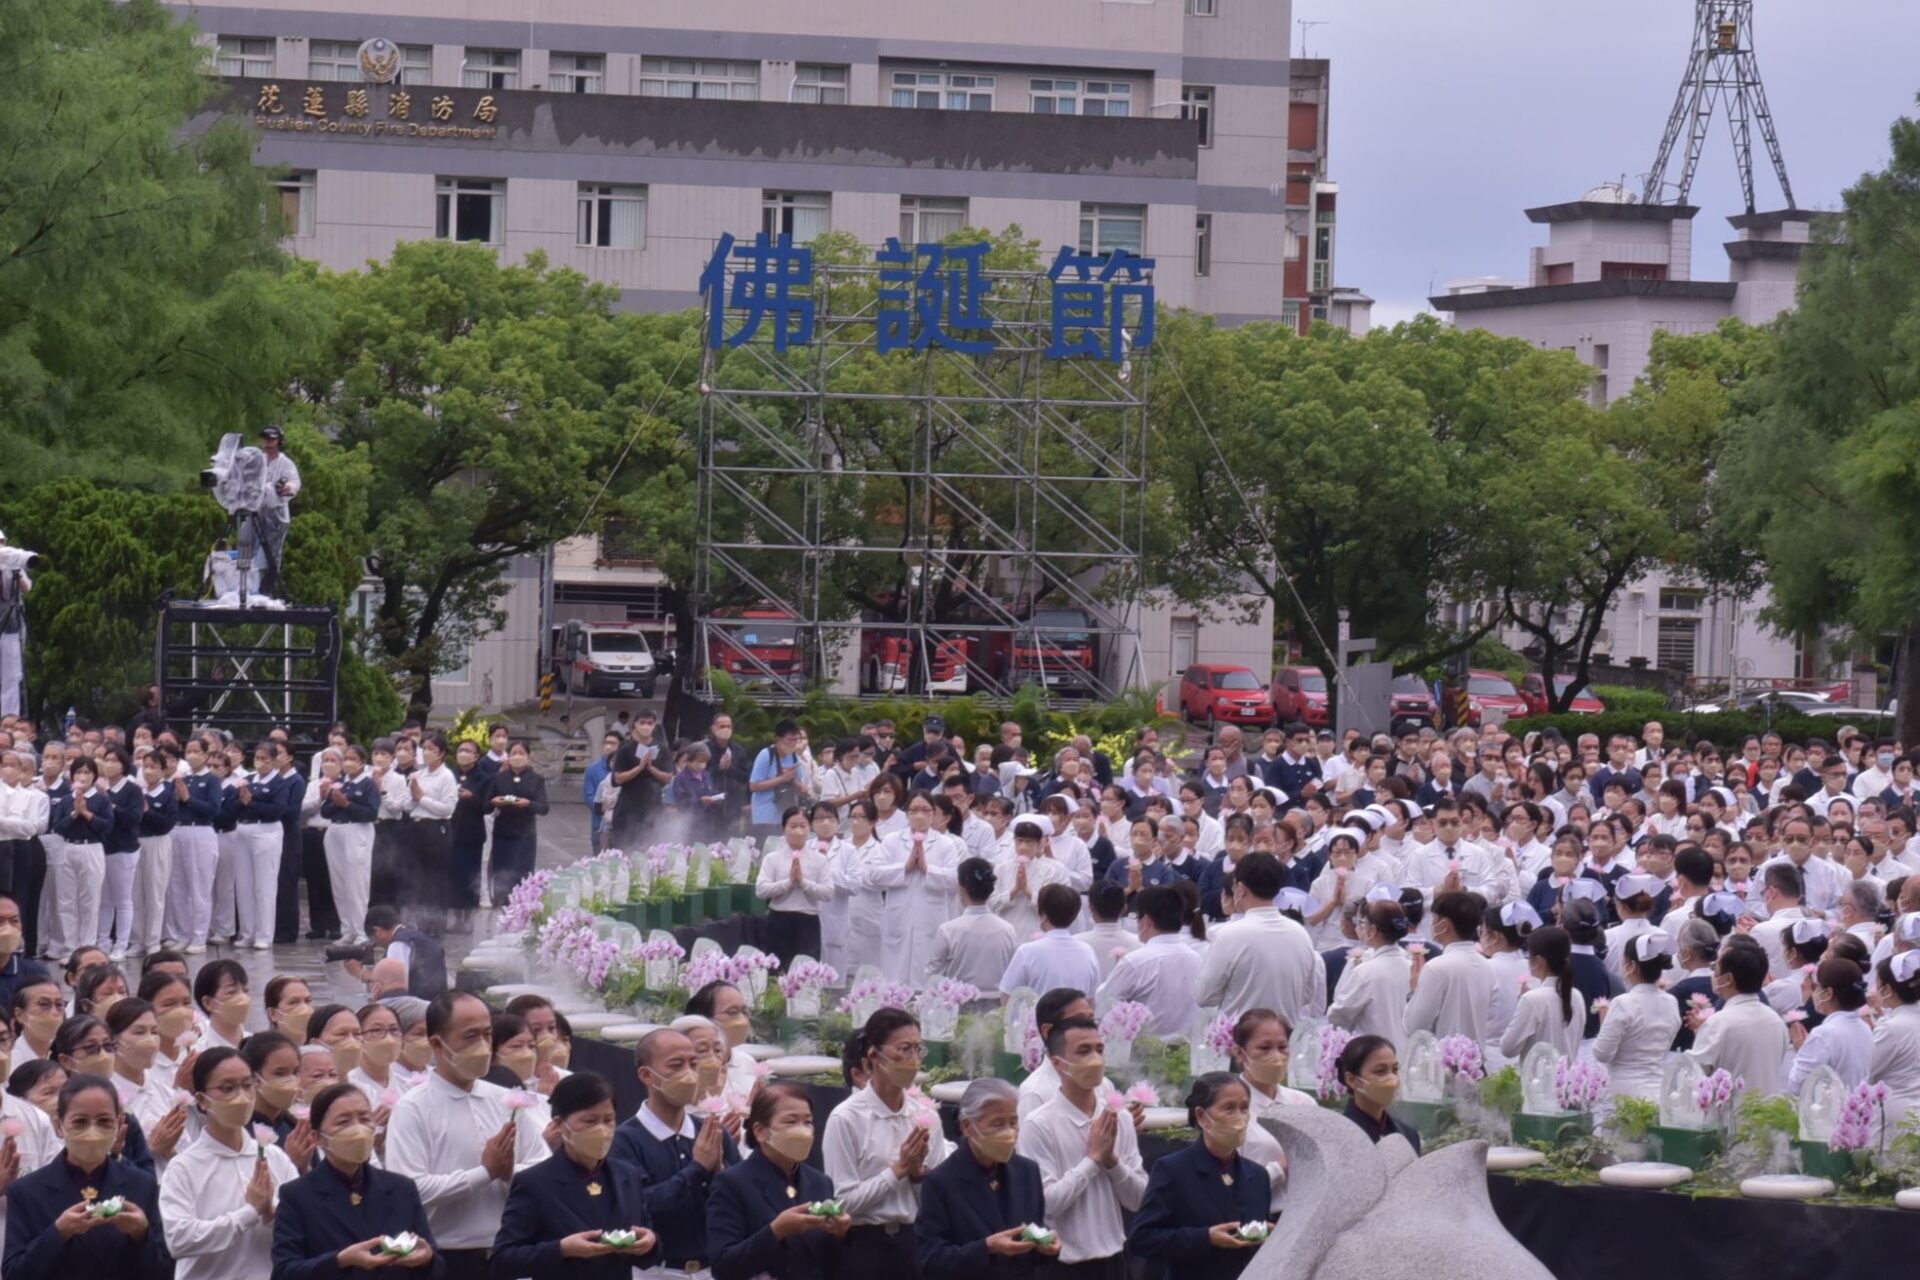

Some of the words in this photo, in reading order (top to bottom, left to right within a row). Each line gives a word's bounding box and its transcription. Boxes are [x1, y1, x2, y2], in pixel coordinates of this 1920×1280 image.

[257, 84, 499, 123] 花蓮縣消防局
[256, 115, 313, 131] Hualien
[317, 118, 371, 137] County
[374, 120, 405, 136] Fire
[408, 123, 497, 139] Department
[700, 231, 1157, 363] 佛誕節
